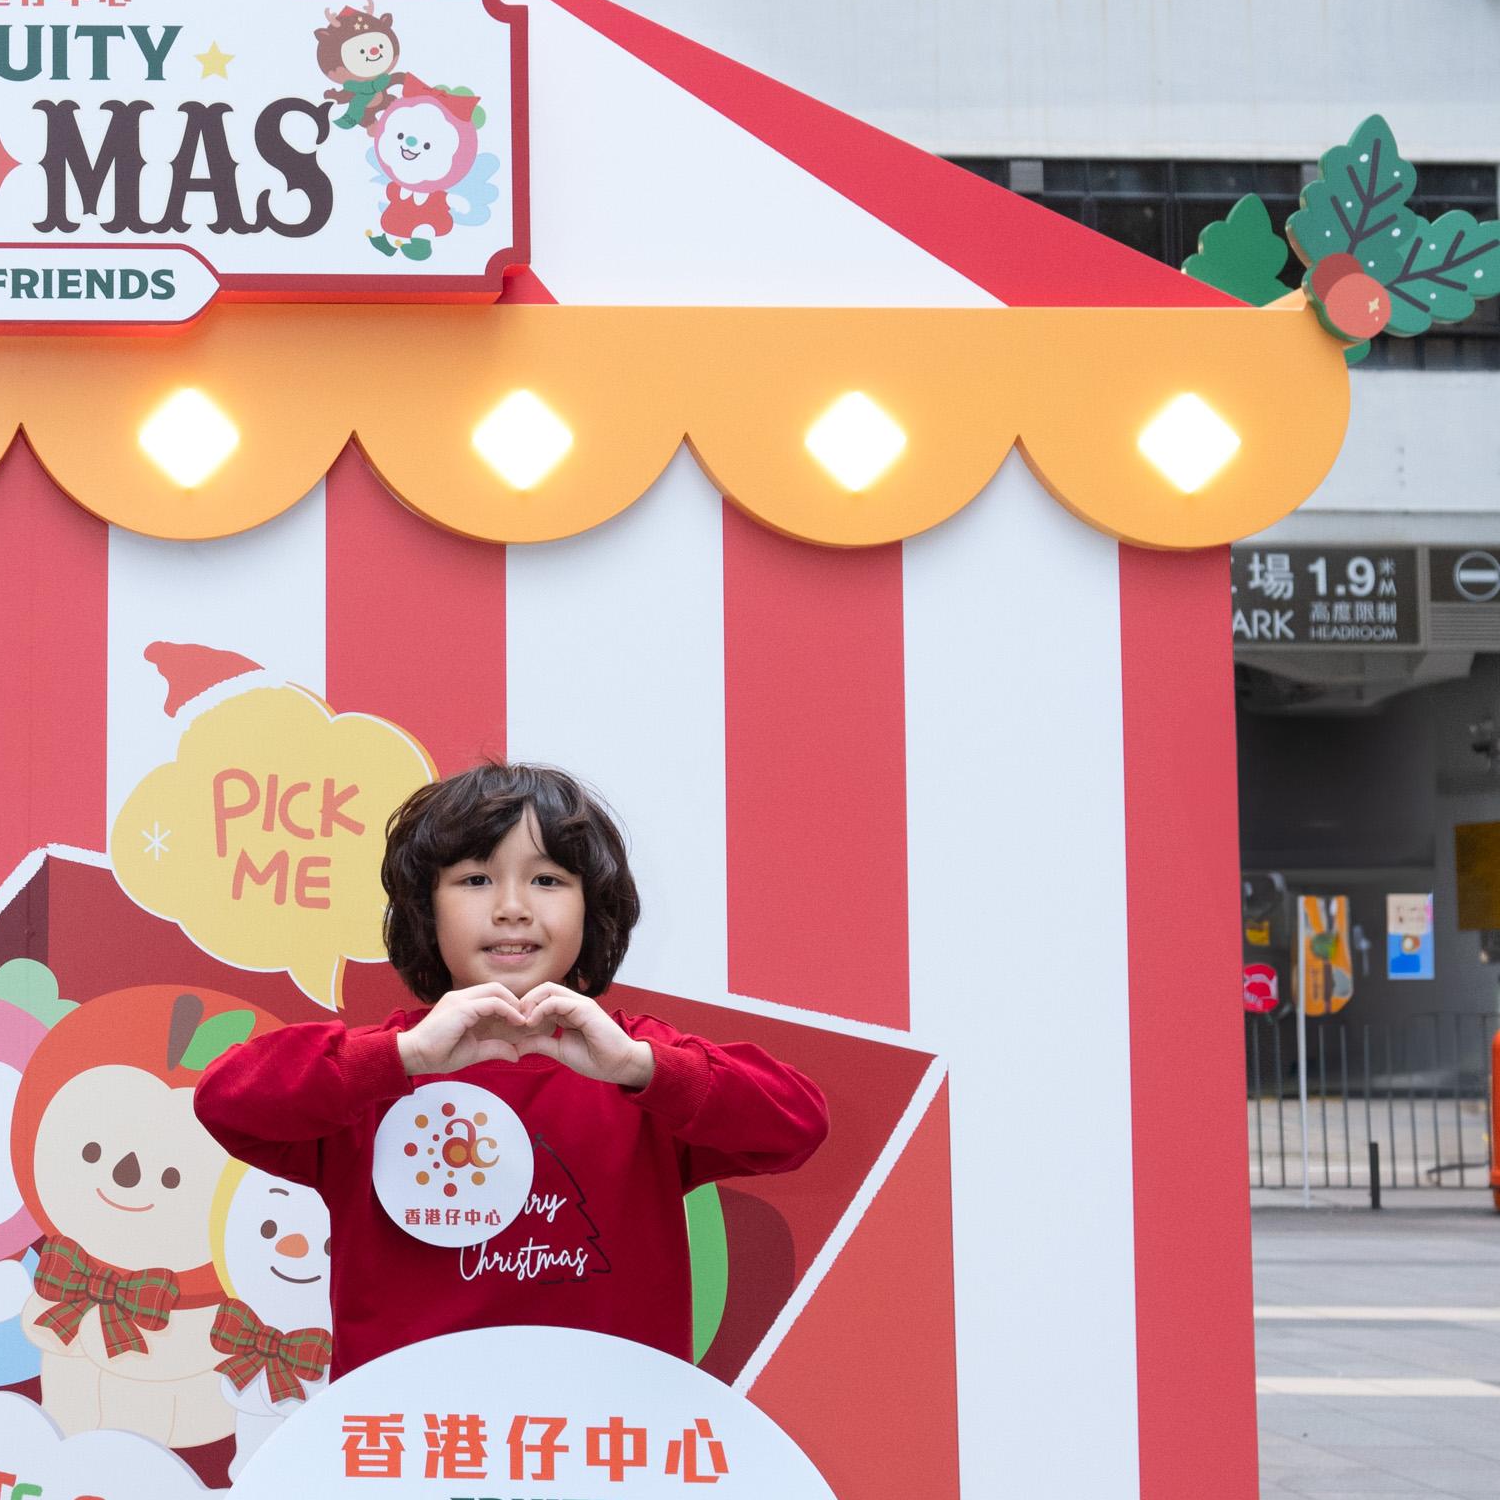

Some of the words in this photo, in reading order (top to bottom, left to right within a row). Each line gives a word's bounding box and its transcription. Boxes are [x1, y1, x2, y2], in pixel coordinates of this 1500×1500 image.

[1232, 552, 1295, 600] 場
[1307, 556, 1376, 597] 1.9
[1233, 609, 1295, 640] ARK
[1310, 601, 1397, 624] 高度限制
[1309, 626, 1398, 641] HEADROOM
[212, 768, 366, 858] PICK
[231, 855, 331, 910] ME
[404, 1209, 501, 1226] 香港仔中心
[342, 1412, 730, 1484] 香港仔中心
